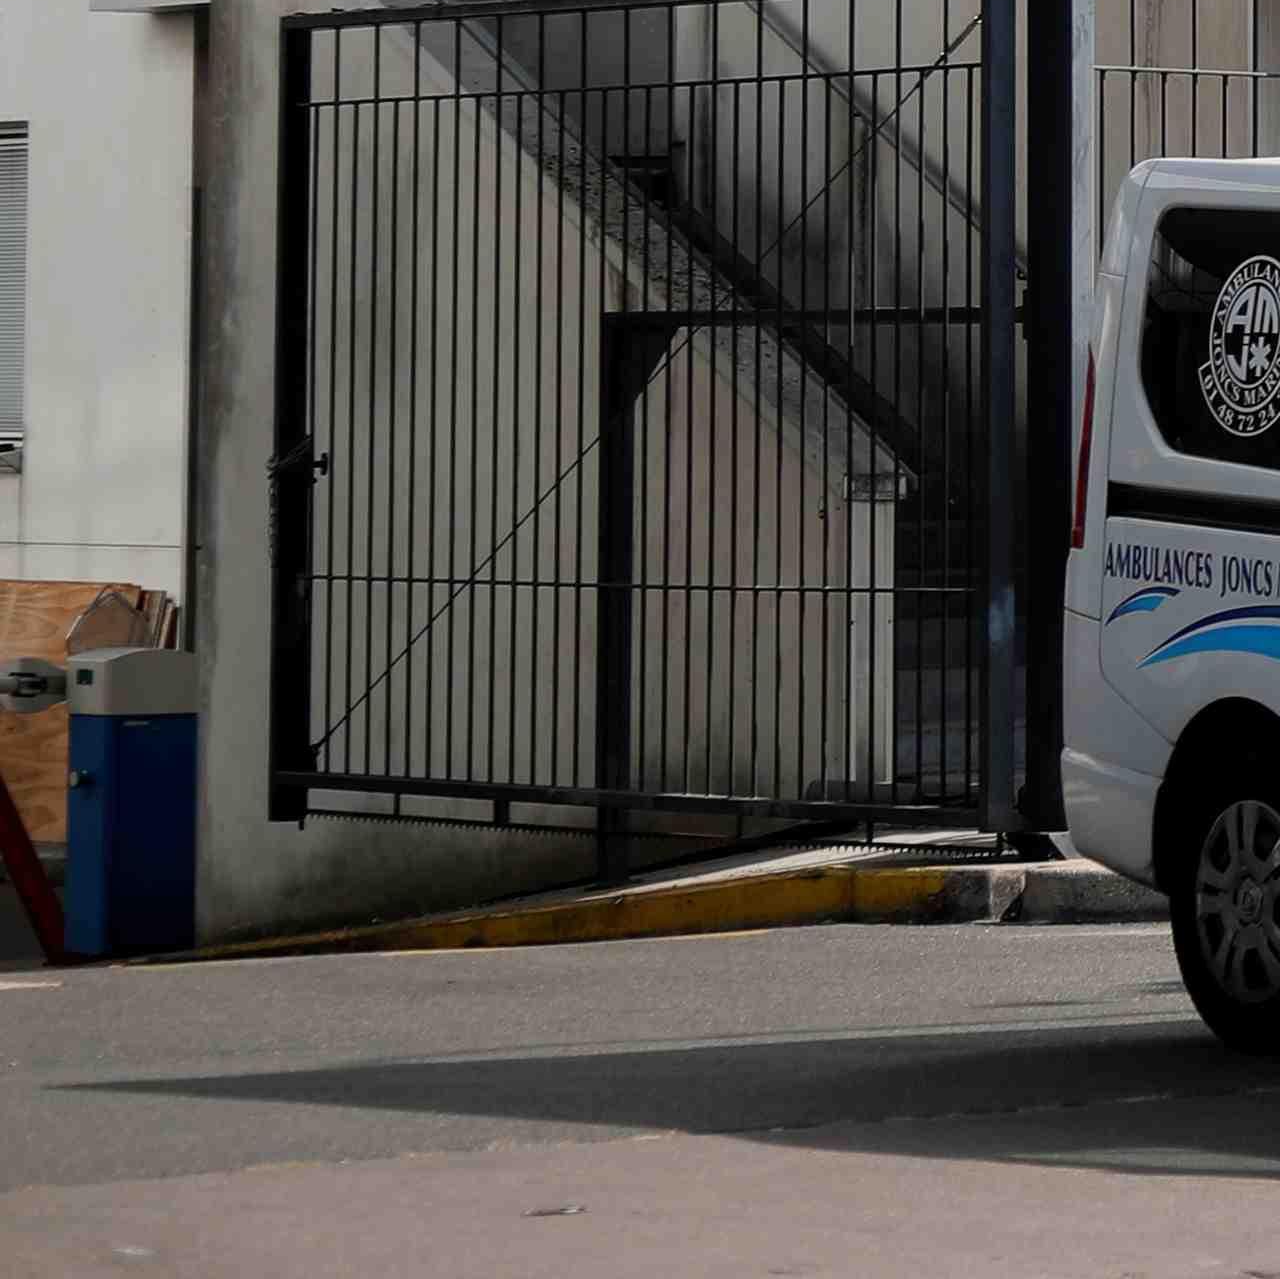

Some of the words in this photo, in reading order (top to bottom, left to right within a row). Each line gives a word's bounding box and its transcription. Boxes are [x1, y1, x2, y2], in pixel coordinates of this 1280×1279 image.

[1212, 331, 1241, 403] JONCS
[1217, 403, 1236, 426] 48
[1237, 414, 1256, 431] 72
[1258, 403, 1277, 427] 24
[1104, 542, 1213, 588] AMBULANCES
[1220, 555, 1273, 598] JONCS
